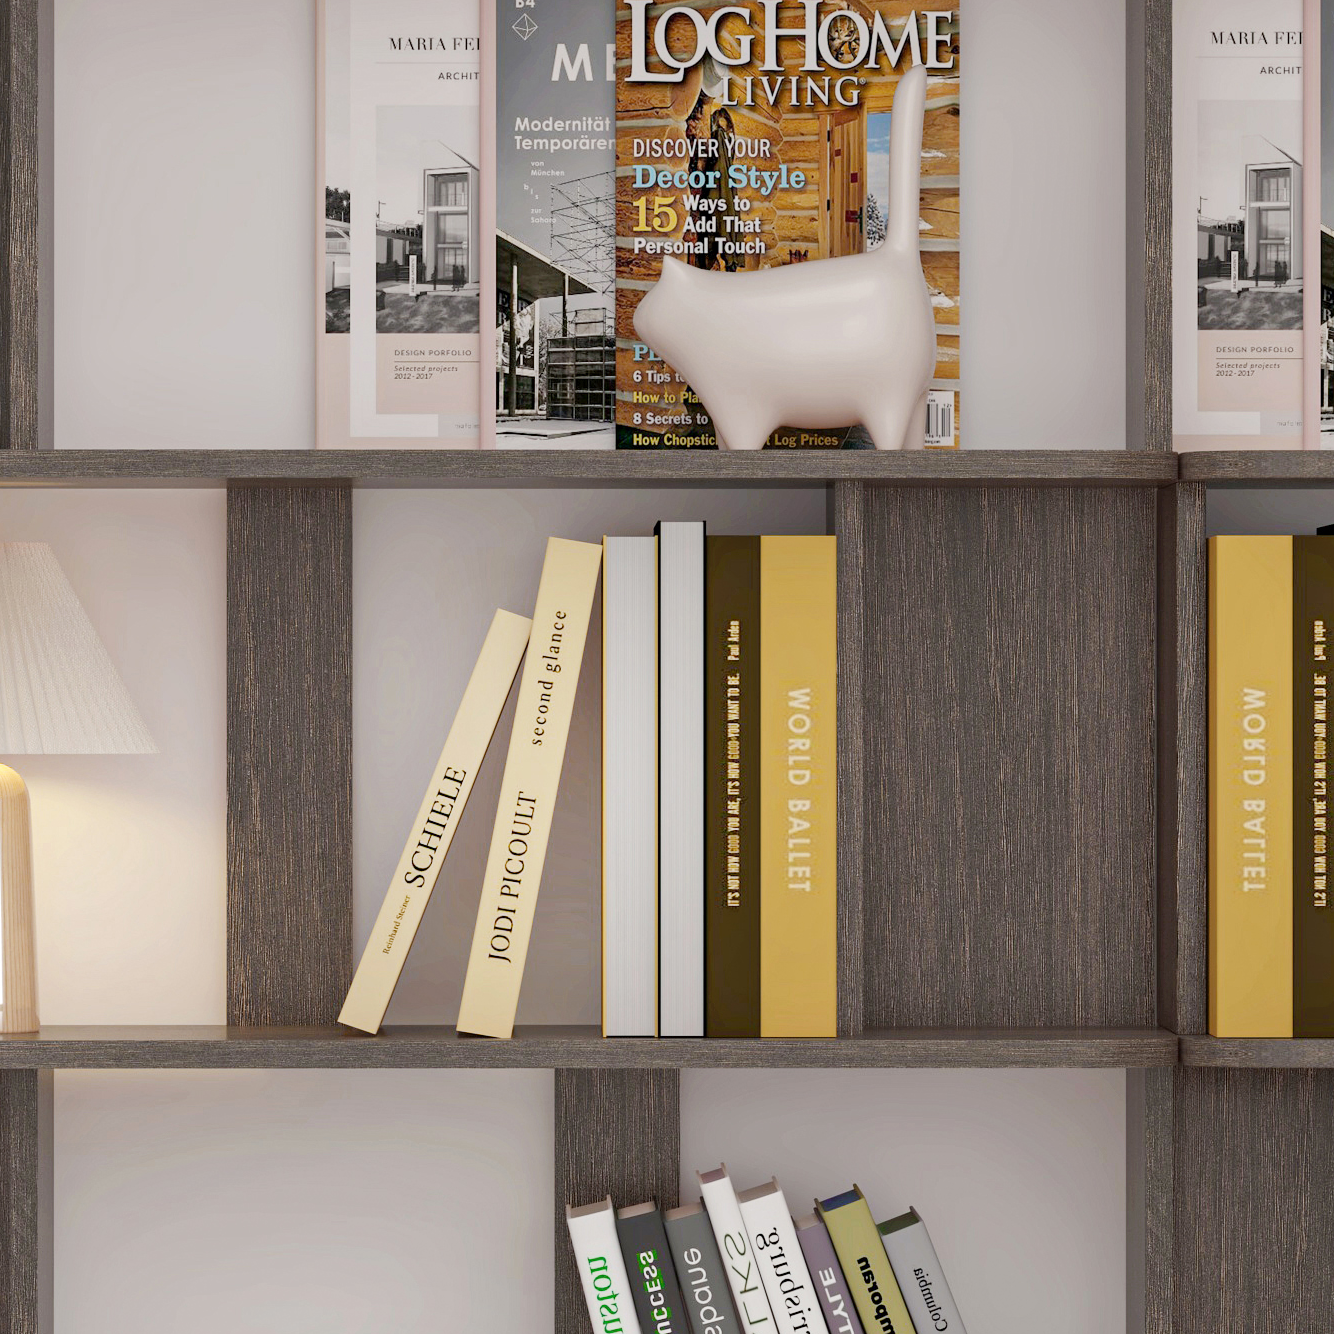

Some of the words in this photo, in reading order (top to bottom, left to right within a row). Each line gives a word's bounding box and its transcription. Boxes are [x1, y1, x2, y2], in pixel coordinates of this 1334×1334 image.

[388, 35, 447, 51] MARIA
[513, 115, 610, 131] Modernität
[632, 137, 718, 158] DISCOVER
[723, 137, 770, 158] YOUR
[543, 610, 568, 673] glance
[530, 678, 554, 745] second
[786, 687, 810, 784] WORLD
[403, 766, 467, 887] SCHIELE
[498, 790, 536, 898] PICOULT
[786, 798, 810, 891] BALLET
[488, 905, 516, 963] JODI
